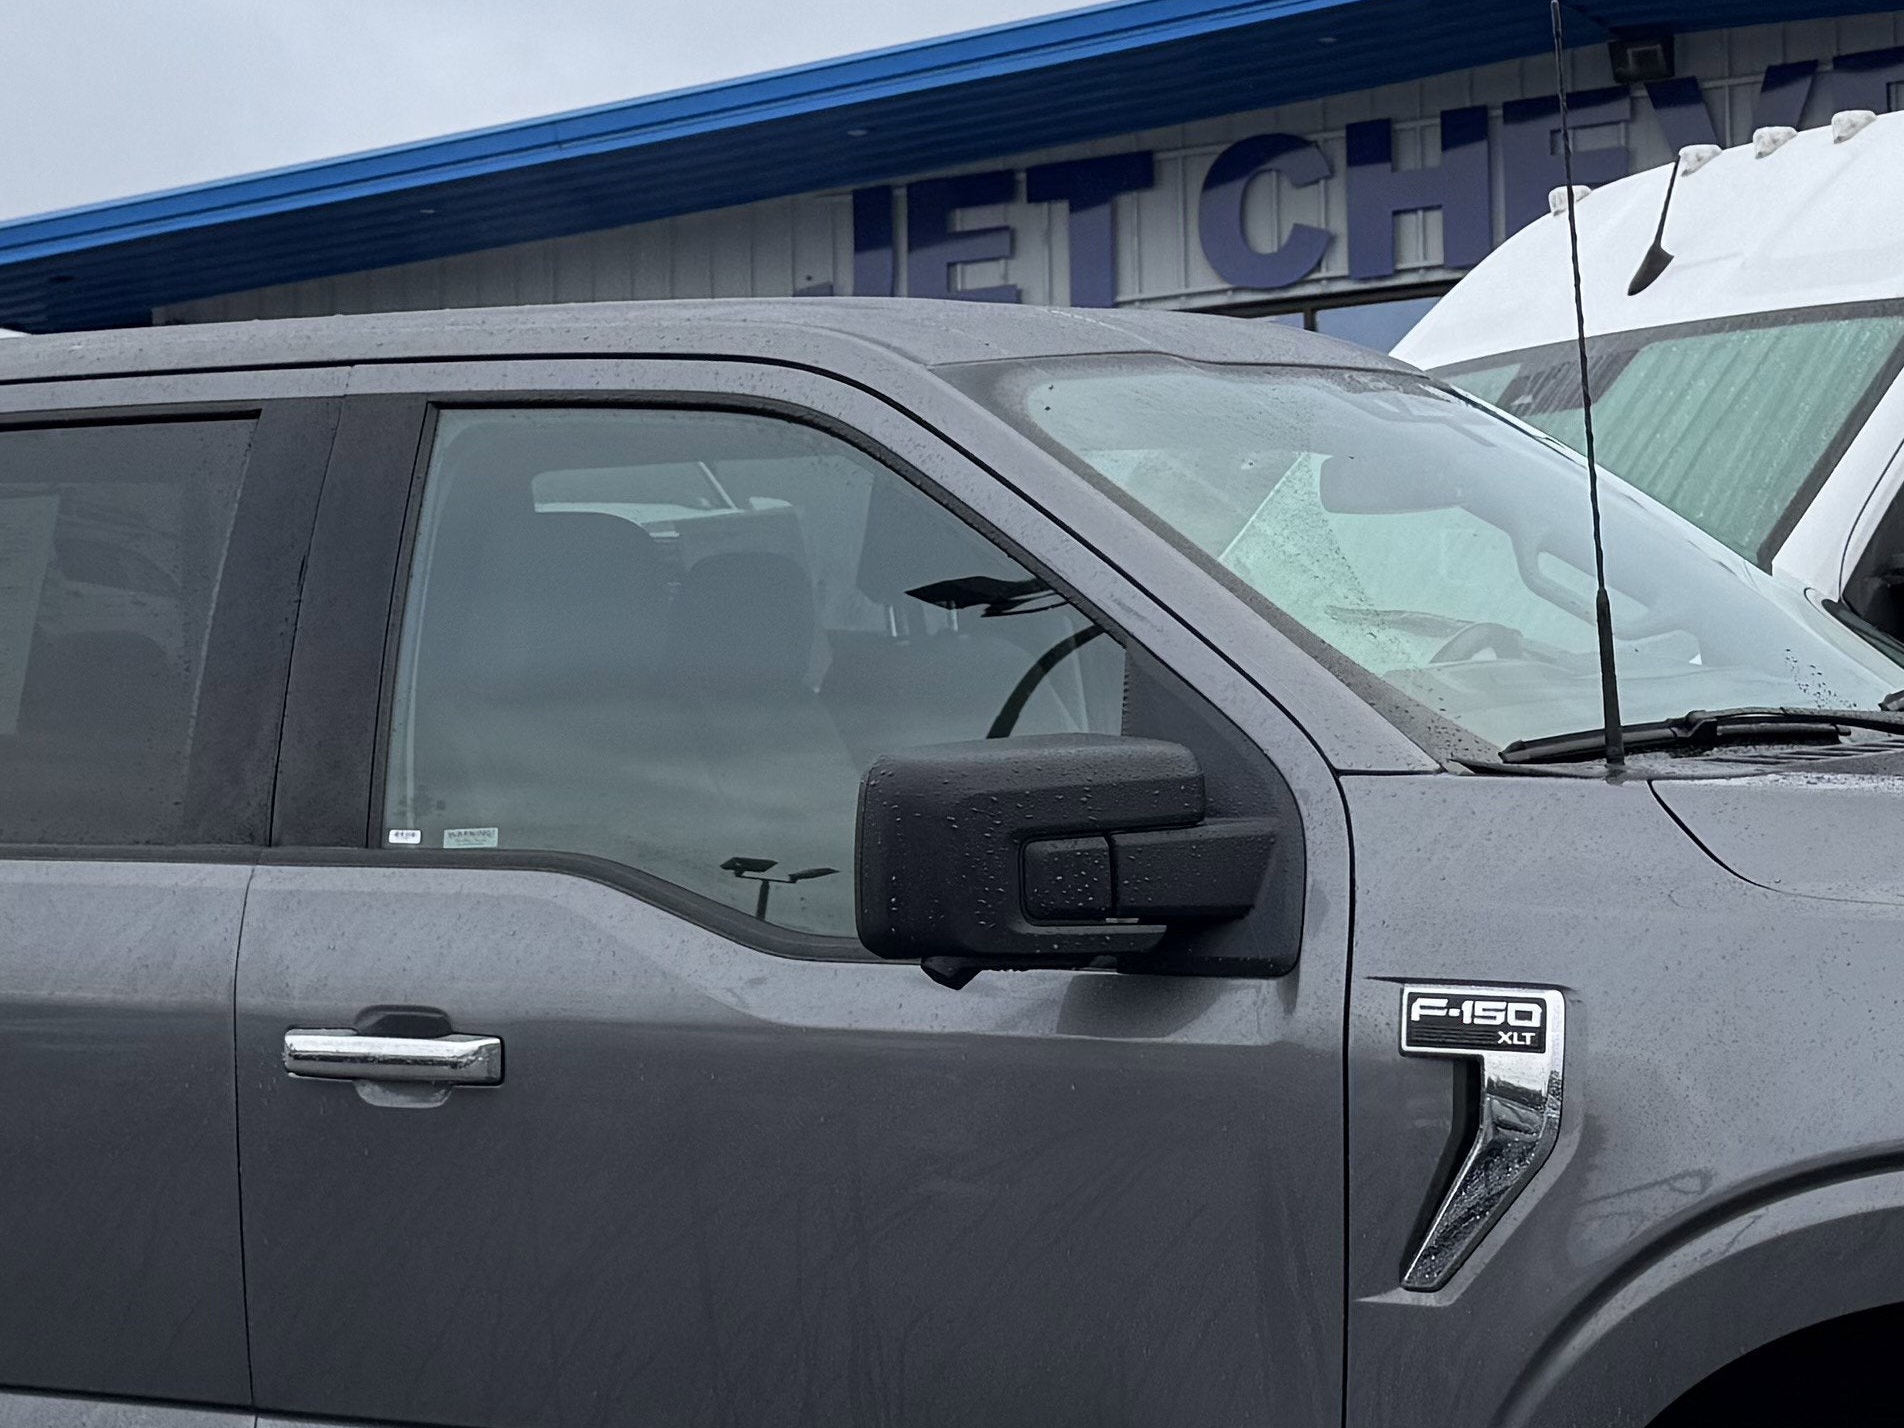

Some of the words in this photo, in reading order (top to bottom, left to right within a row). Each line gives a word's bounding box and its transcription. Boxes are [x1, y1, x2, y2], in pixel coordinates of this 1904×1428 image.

[793, 151, 1155, 309] JET
[1411, 997, 1543, 1027] F-150
[1497, 1030, 1536, 1045] XLT
